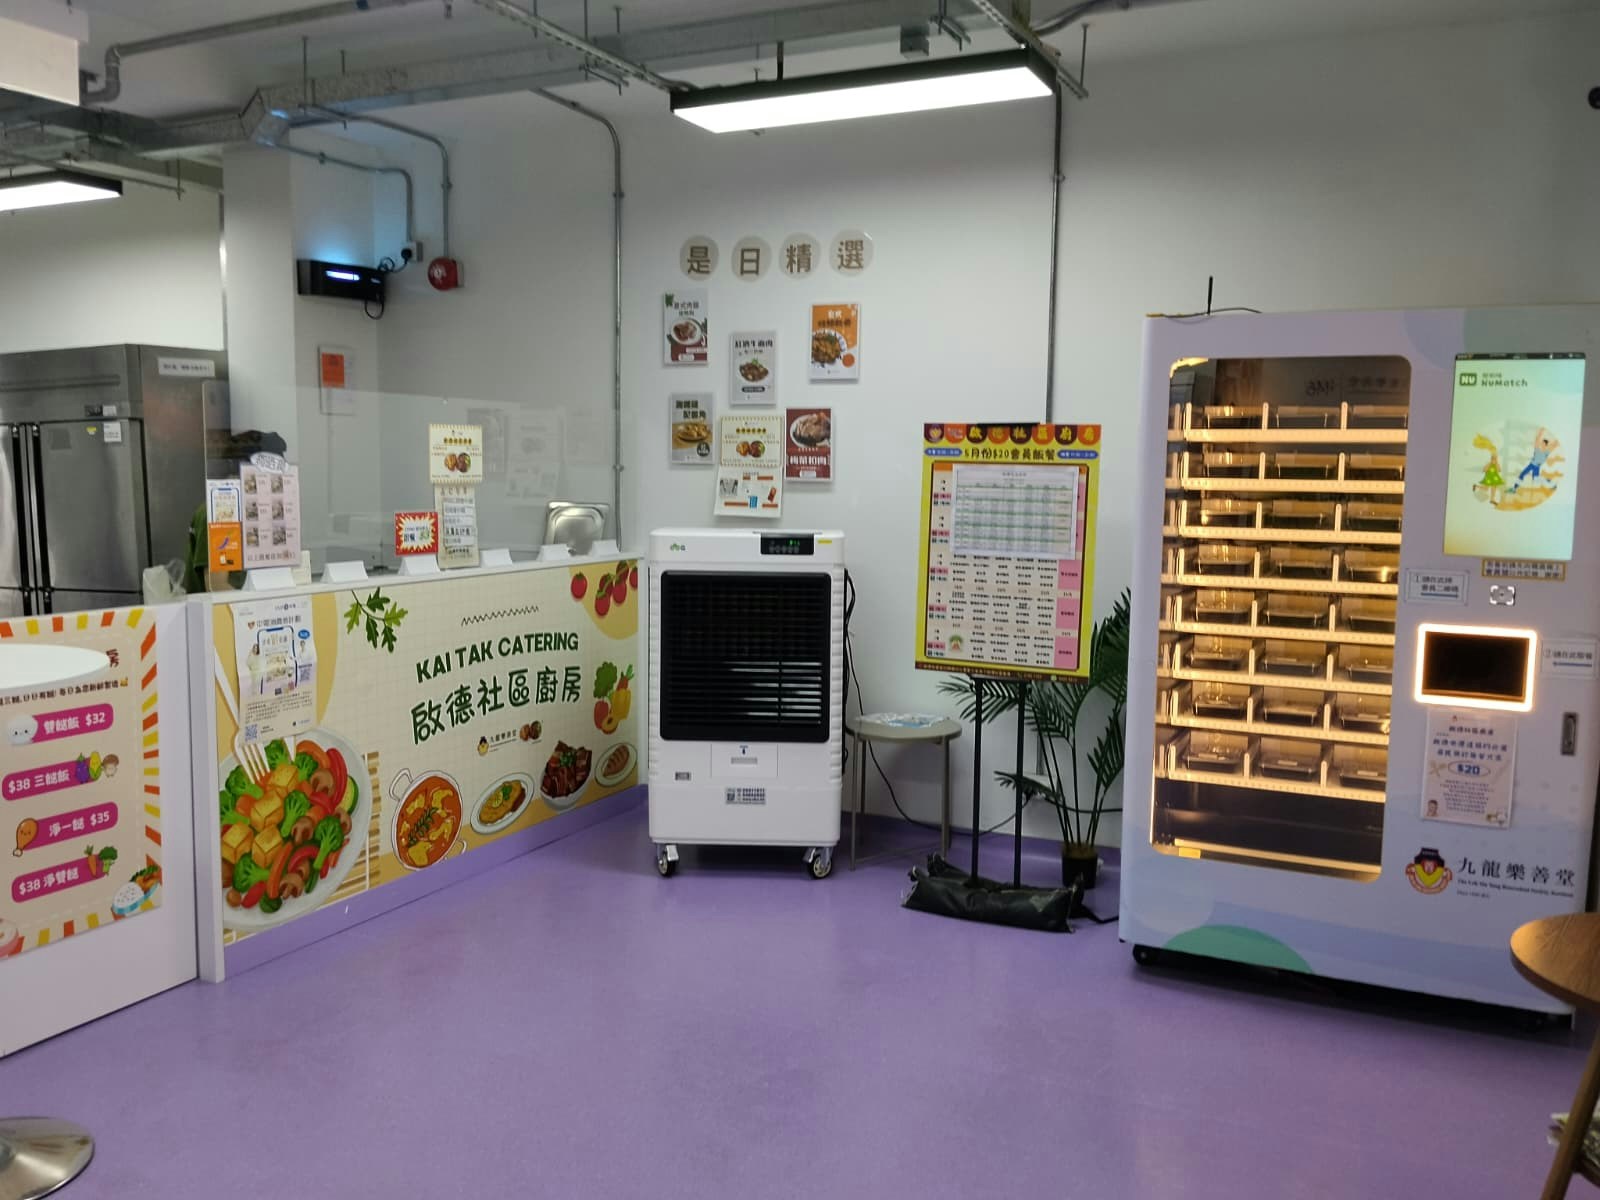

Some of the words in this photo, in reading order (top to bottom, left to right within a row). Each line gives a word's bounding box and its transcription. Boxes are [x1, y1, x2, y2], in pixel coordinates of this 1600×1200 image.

[687, 239, 864, 276] 是日精選
[416, 652, 451, 684] KAI
[455, 640, 494, 668] TAK
[498, 632, 579, 657] CATERING
[411, 666, 581, 745] 啟德社區廚房
[85, 711, 106, 727] $32
[8, 777, 30, 793] $38
[34, 769, 70, 787] 三餸飯
[1457, 764, 1480, 775] $20
[49, 817, 84, 836] 淨一餸
[90, 811, 110, 827] $35
[1459, 857, 1575, 888] 九龍樂善堂
[19, 879, 40, 895] $38
